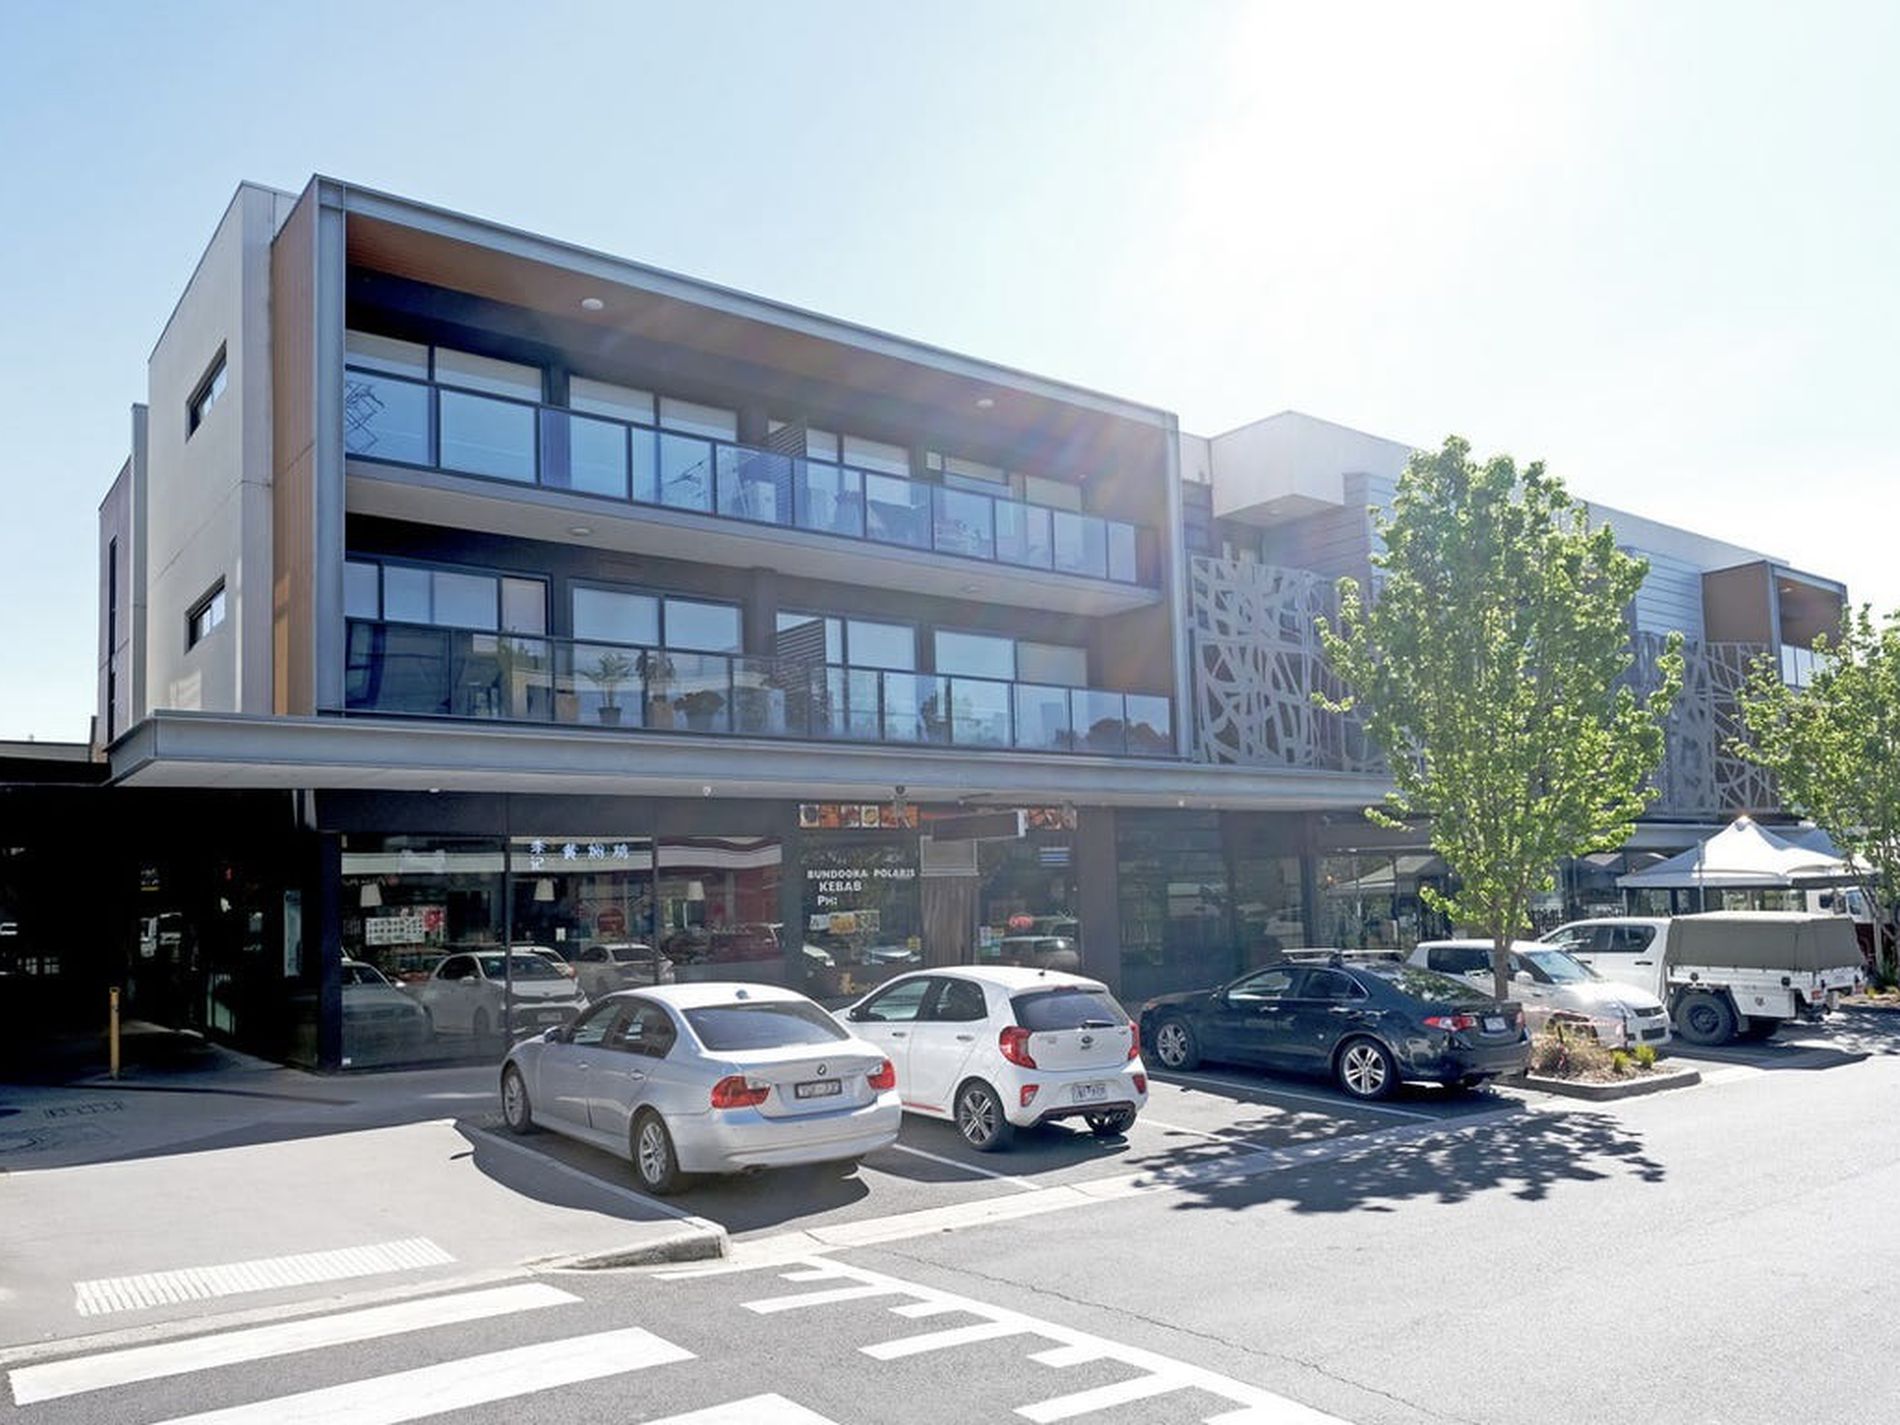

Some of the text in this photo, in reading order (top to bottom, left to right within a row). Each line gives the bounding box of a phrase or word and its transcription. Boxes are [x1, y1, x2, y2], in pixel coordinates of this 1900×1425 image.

[807, 868, 916, 879] BUNDOORA POLARIS
[819, 880, 862, 892] KEBAB
